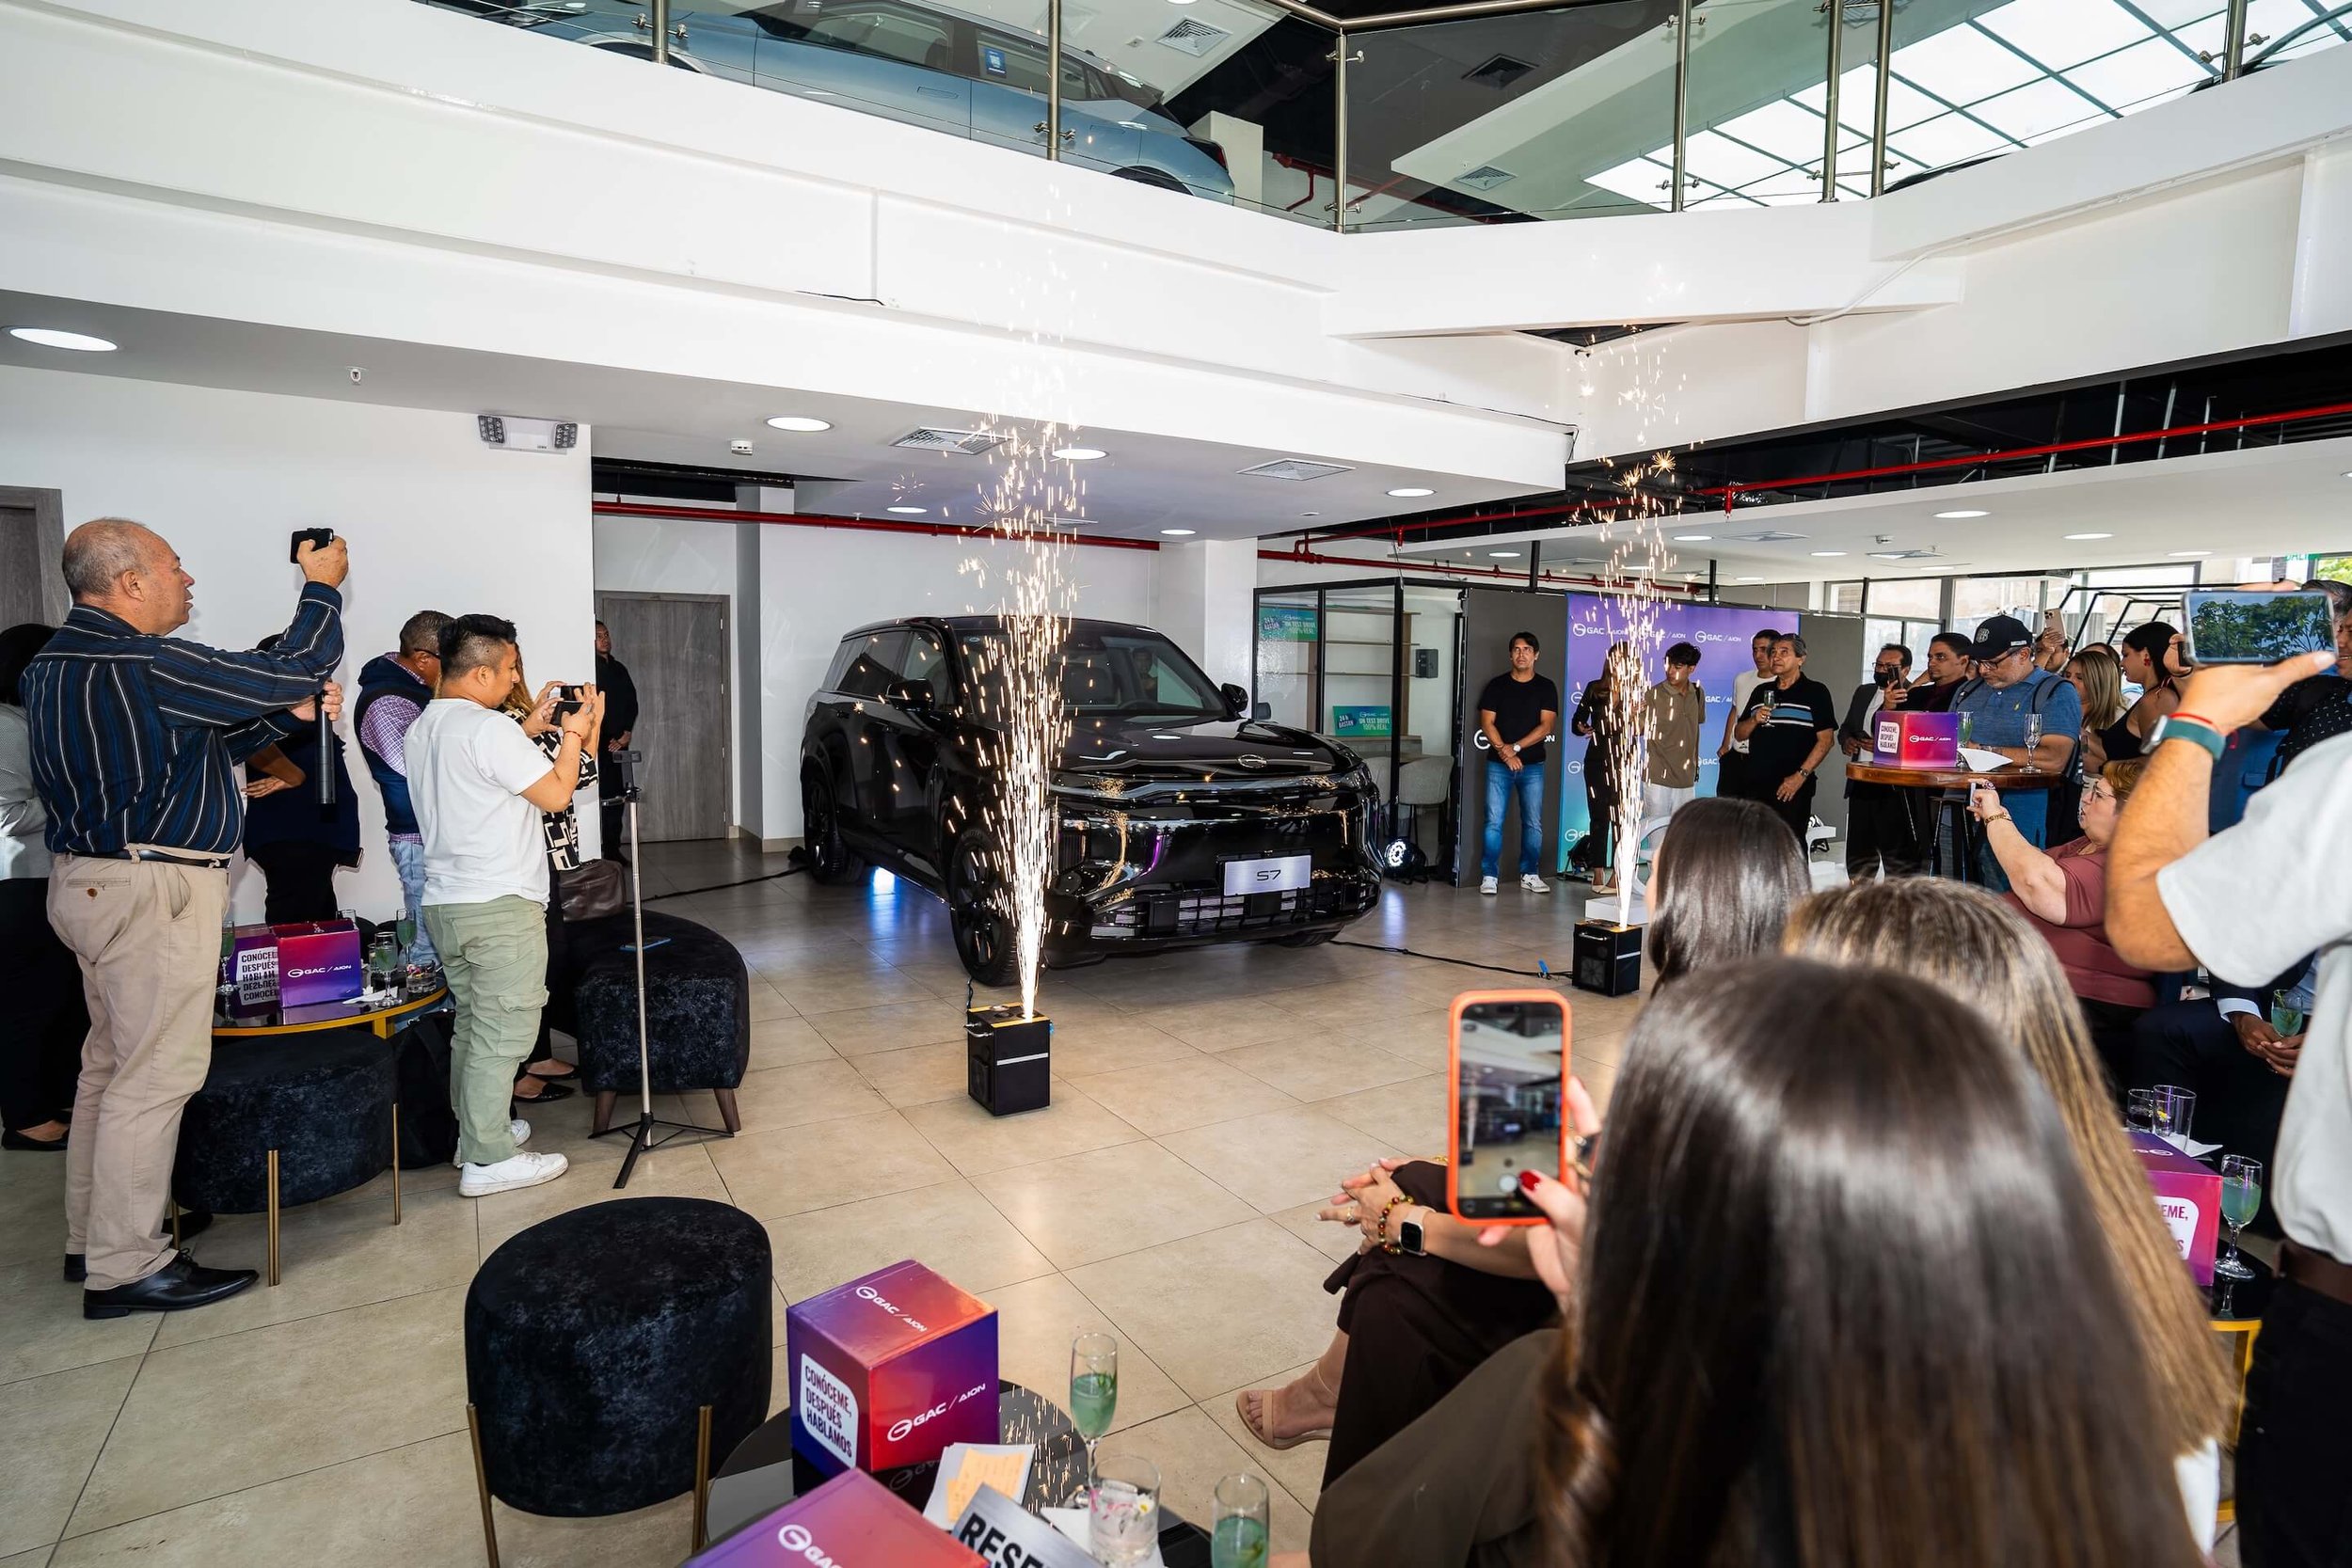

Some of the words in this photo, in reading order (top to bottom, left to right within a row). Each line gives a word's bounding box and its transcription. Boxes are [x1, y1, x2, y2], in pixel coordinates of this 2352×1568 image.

[1586, 626, 1605, 635] GAC
[1257, 869, 1281, 881] S7
[241, 950, 278, 963] CONÓCE
[872, 1296, 900, 1314] GAC
[902, 1317, 928, 1332] AION
[804, 1365, 852, 1418] CONÓCEME,
[805, 1386, 842, 1429] DESPUÉS
[913, 1402, 946, 1427] GAC
[958, 1383, 986, 1403] AION
[806, 1406, 852, 1458] HABLAMOS
[803, 1545, 844, 1568] GA
